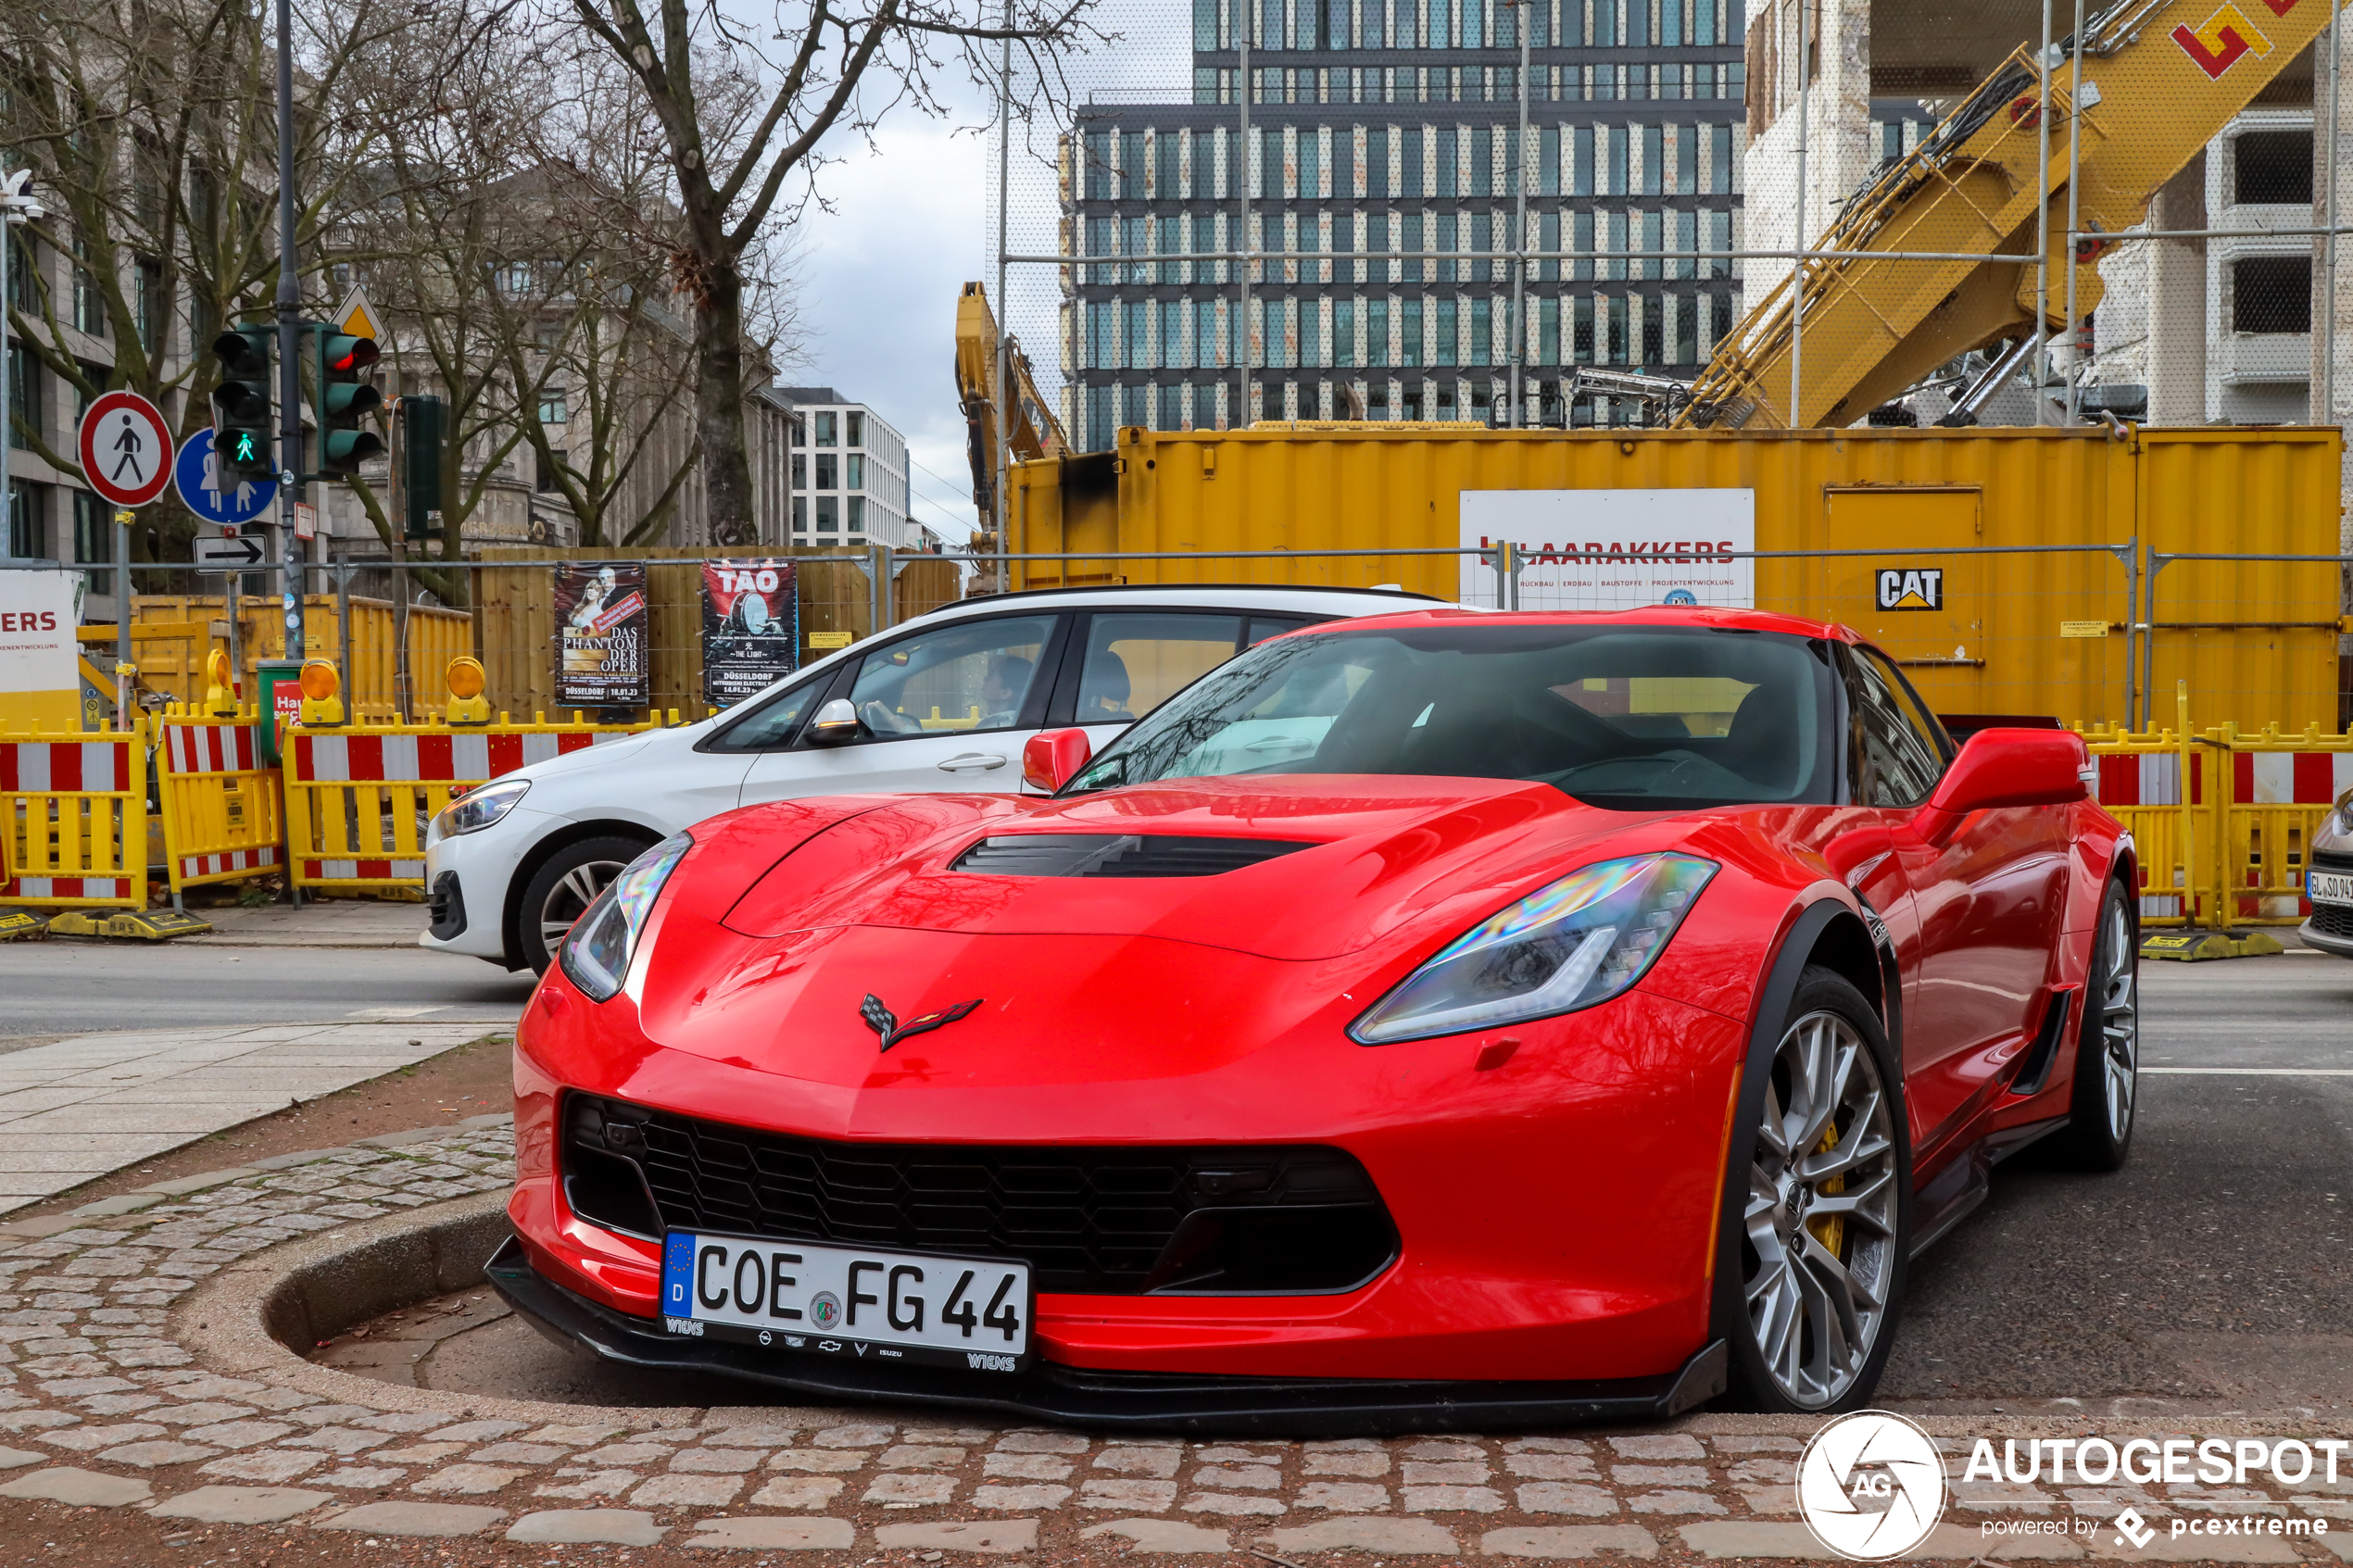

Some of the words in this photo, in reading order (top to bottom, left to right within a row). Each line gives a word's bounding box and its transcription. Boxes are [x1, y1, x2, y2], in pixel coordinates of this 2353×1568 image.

[718, 571, 778, 593] TAO
[1881, 571, 1941, 608] CAT
[611, 626, 637, 639] DAS
[563, 638, 637, 650] PHANTOM
[610, 649, 637, 660] DER
[600, 660, 637, 672] OPER
[724, 671, 774, 680] DÜSSELDORF
[565, 686, 600, 695] DÜSSELDORF
[2312, 875, 2322, 896] GL
[2328, 877, 2338, 897] SO
[672, 1284, 684, 1302] D
[698, 1245, 803, 1320] COE
[846, 1261, 925, 1332] FG
[941, 1270, 1020, 1341] 44
[666, 1318, 704, 1336] WIENS
[879, 1349, 903, 1358] ISUZU
[967, 1353, 1016, 1372] WIENS
